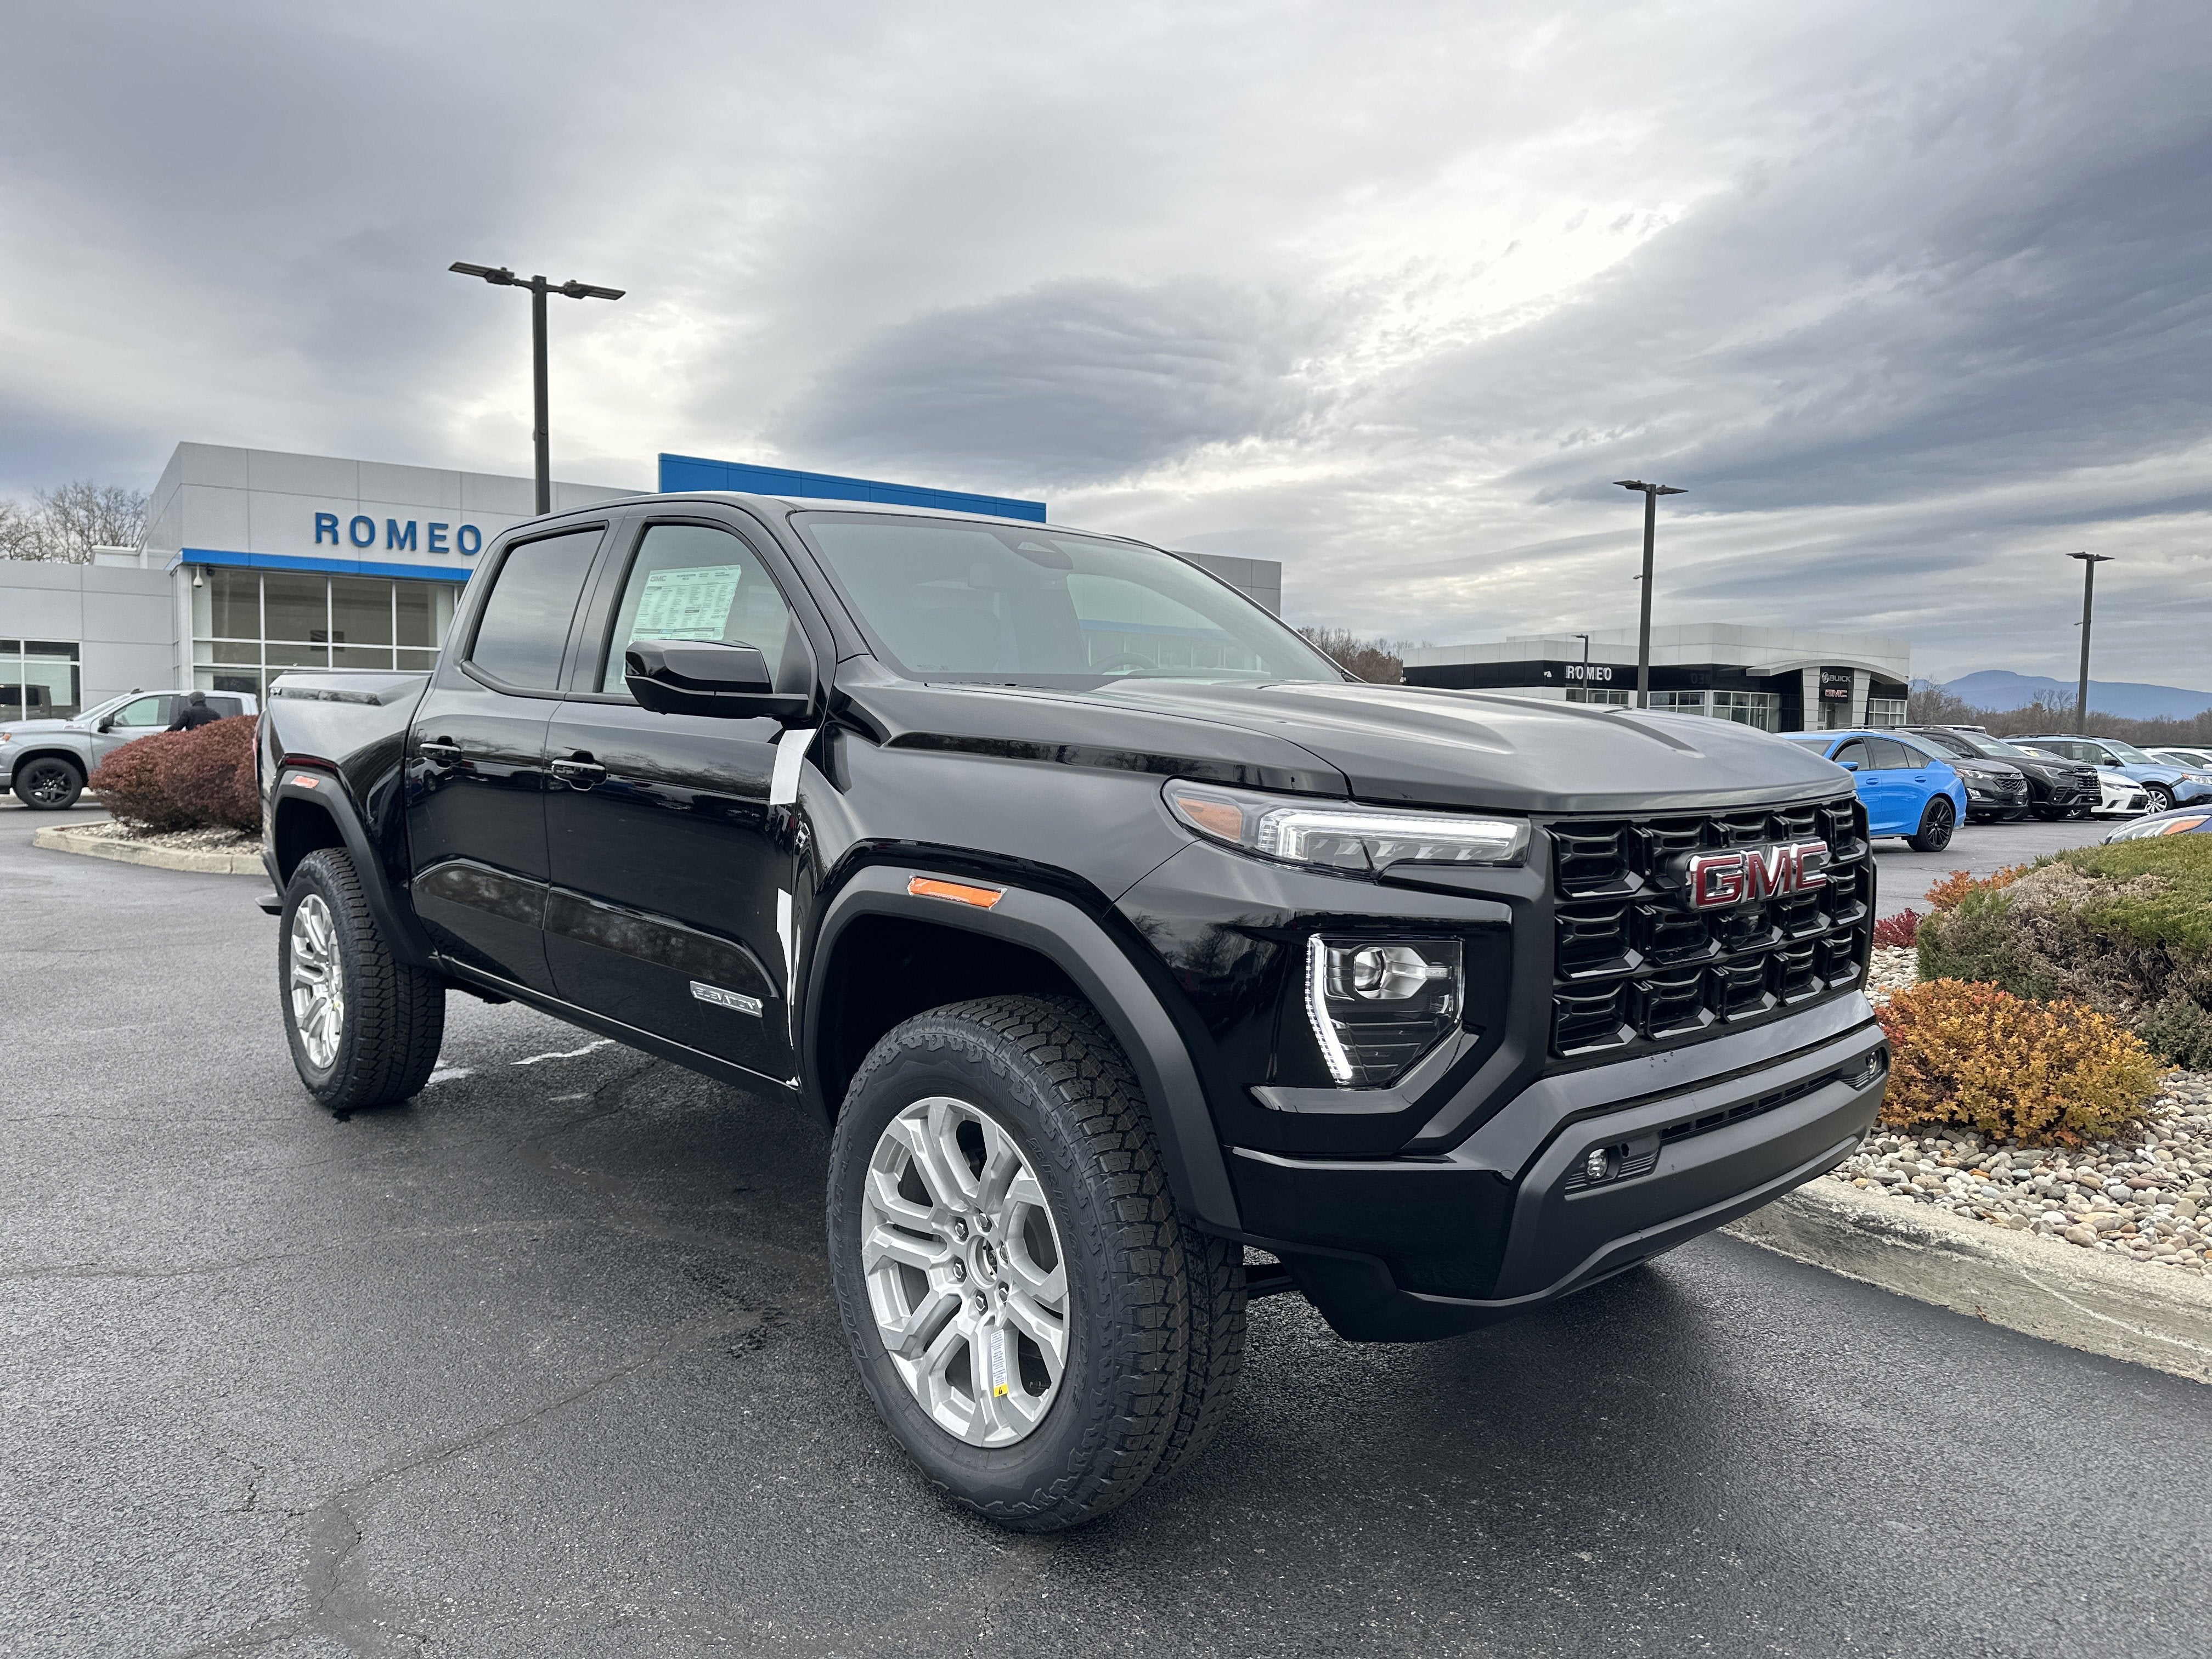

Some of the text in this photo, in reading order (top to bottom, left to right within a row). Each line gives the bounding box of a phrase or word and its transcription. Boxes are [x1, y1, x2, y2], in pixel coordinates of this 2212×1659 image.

[315, 512, 482, 556] ROMEO
[1565, 665, 1612, 681] ROMEO
[1825, 689, 1848, 698] GMC
[1685, 841, 1829, 908] GMC
[1025, 1137, 1090, 1414] BRIDGESTONE
